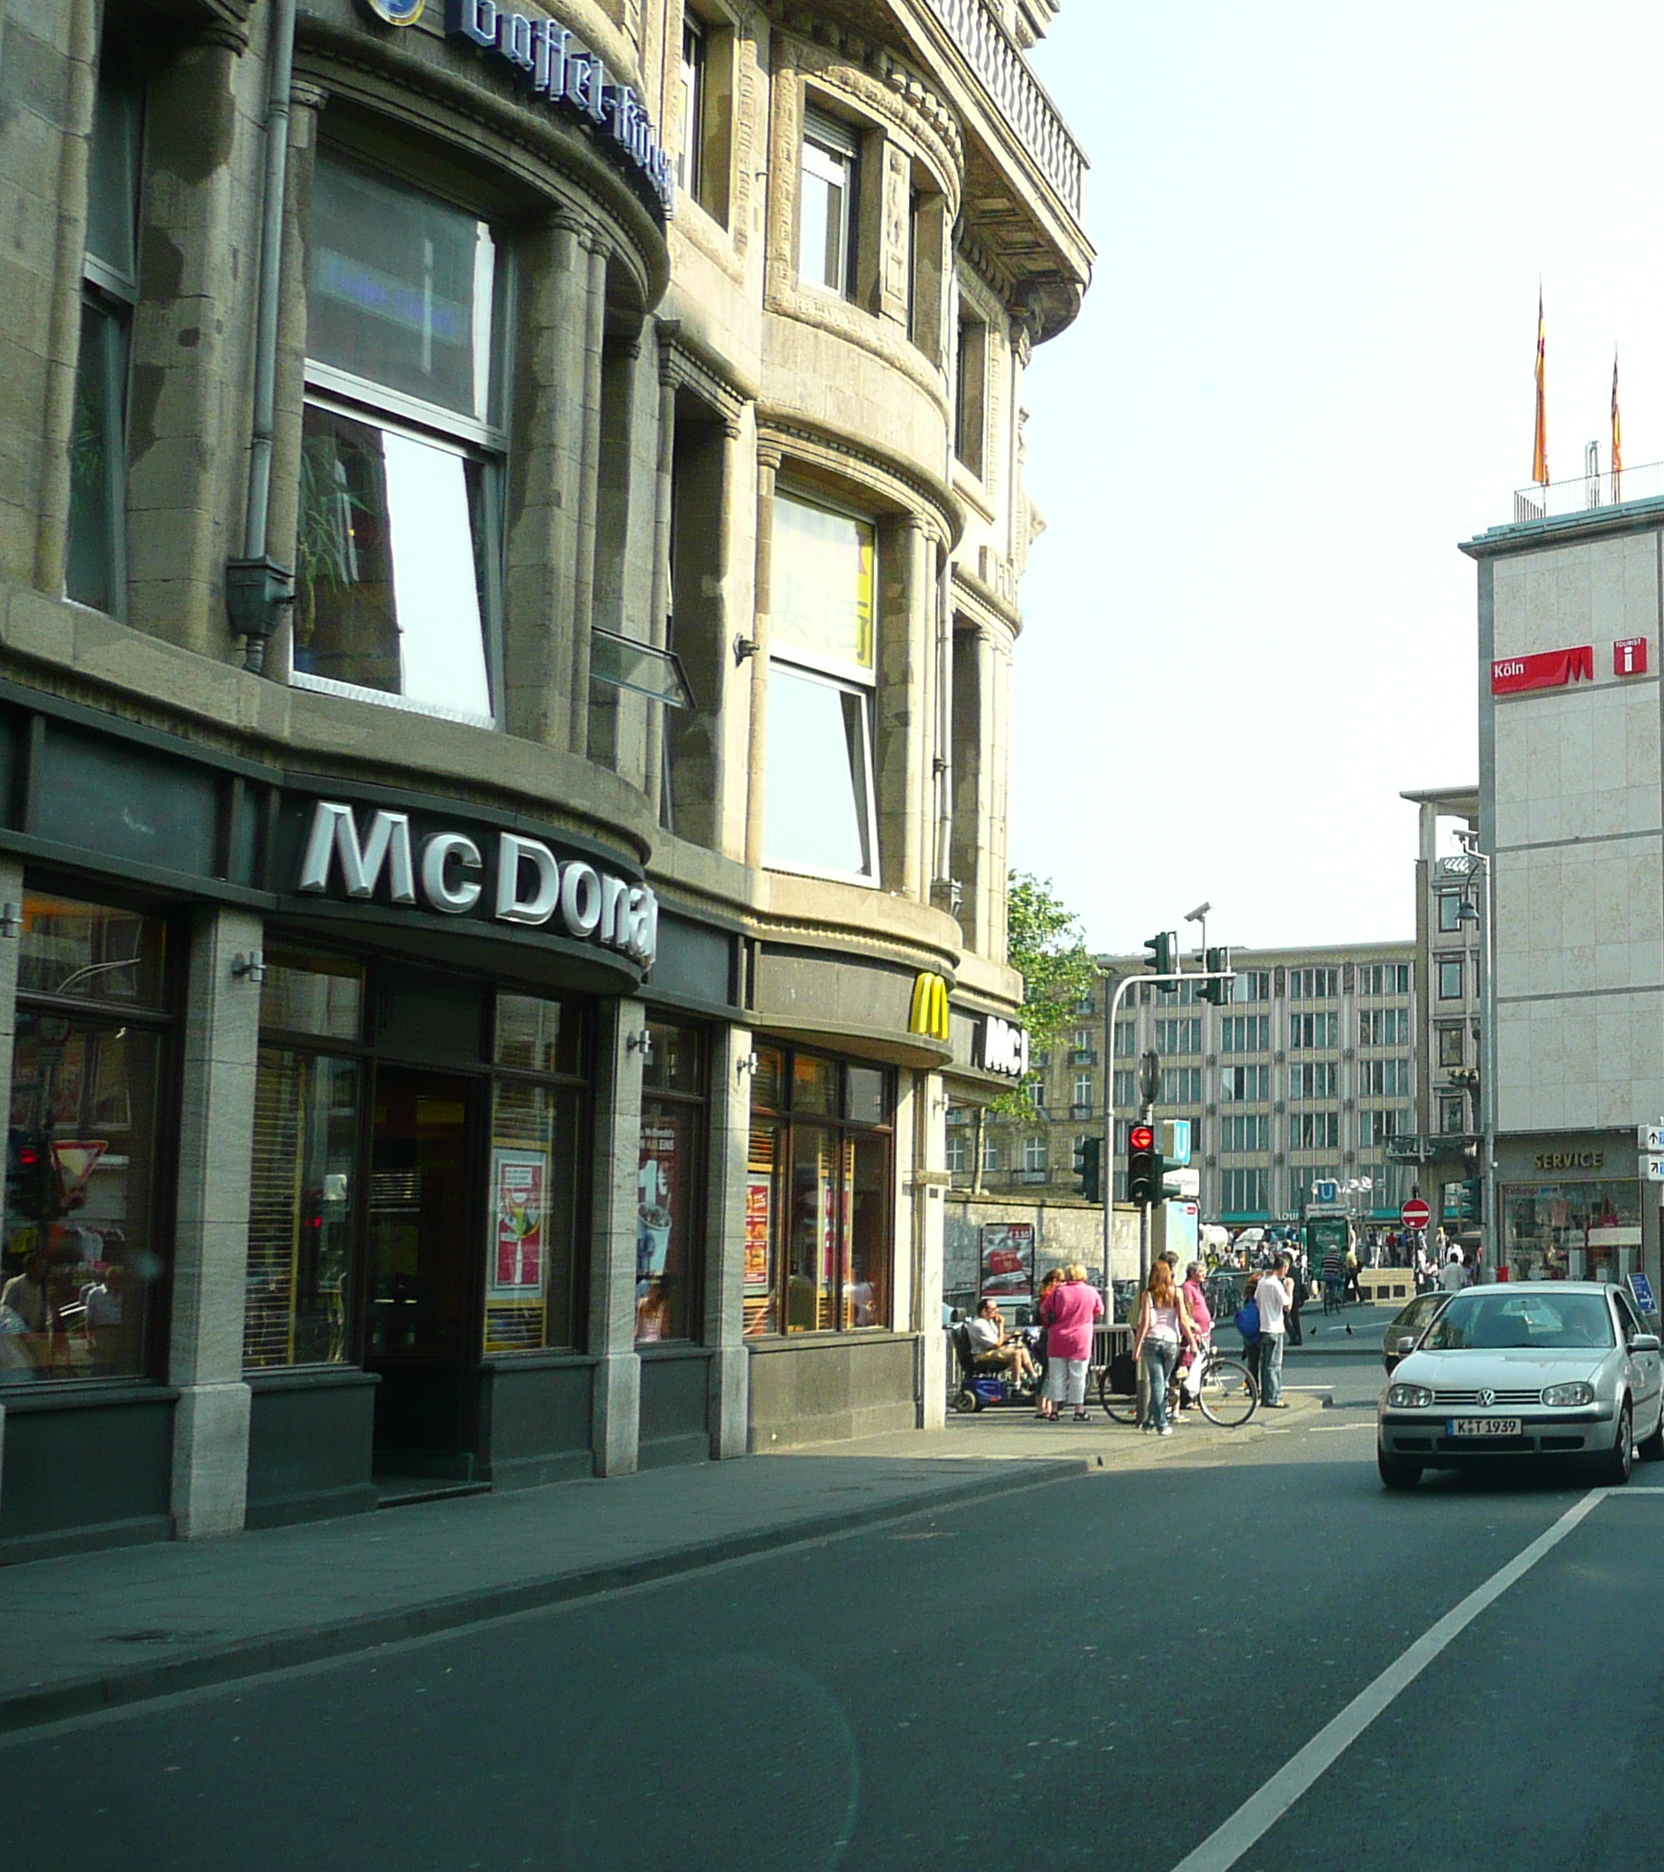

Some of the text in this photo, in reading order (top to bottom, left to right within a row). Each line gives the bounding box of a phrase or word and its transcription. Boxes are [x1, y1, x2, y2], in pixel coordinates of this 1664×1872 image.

[1494, 662, 1525, 678] Köln
[1176, 1126, 1188, 1156] U
[1534, 1152, 1604, 1169] SERVICE
[1320, 1184, 1333, 1199] U
[1485, 1421, 1517, 1433] 1939
